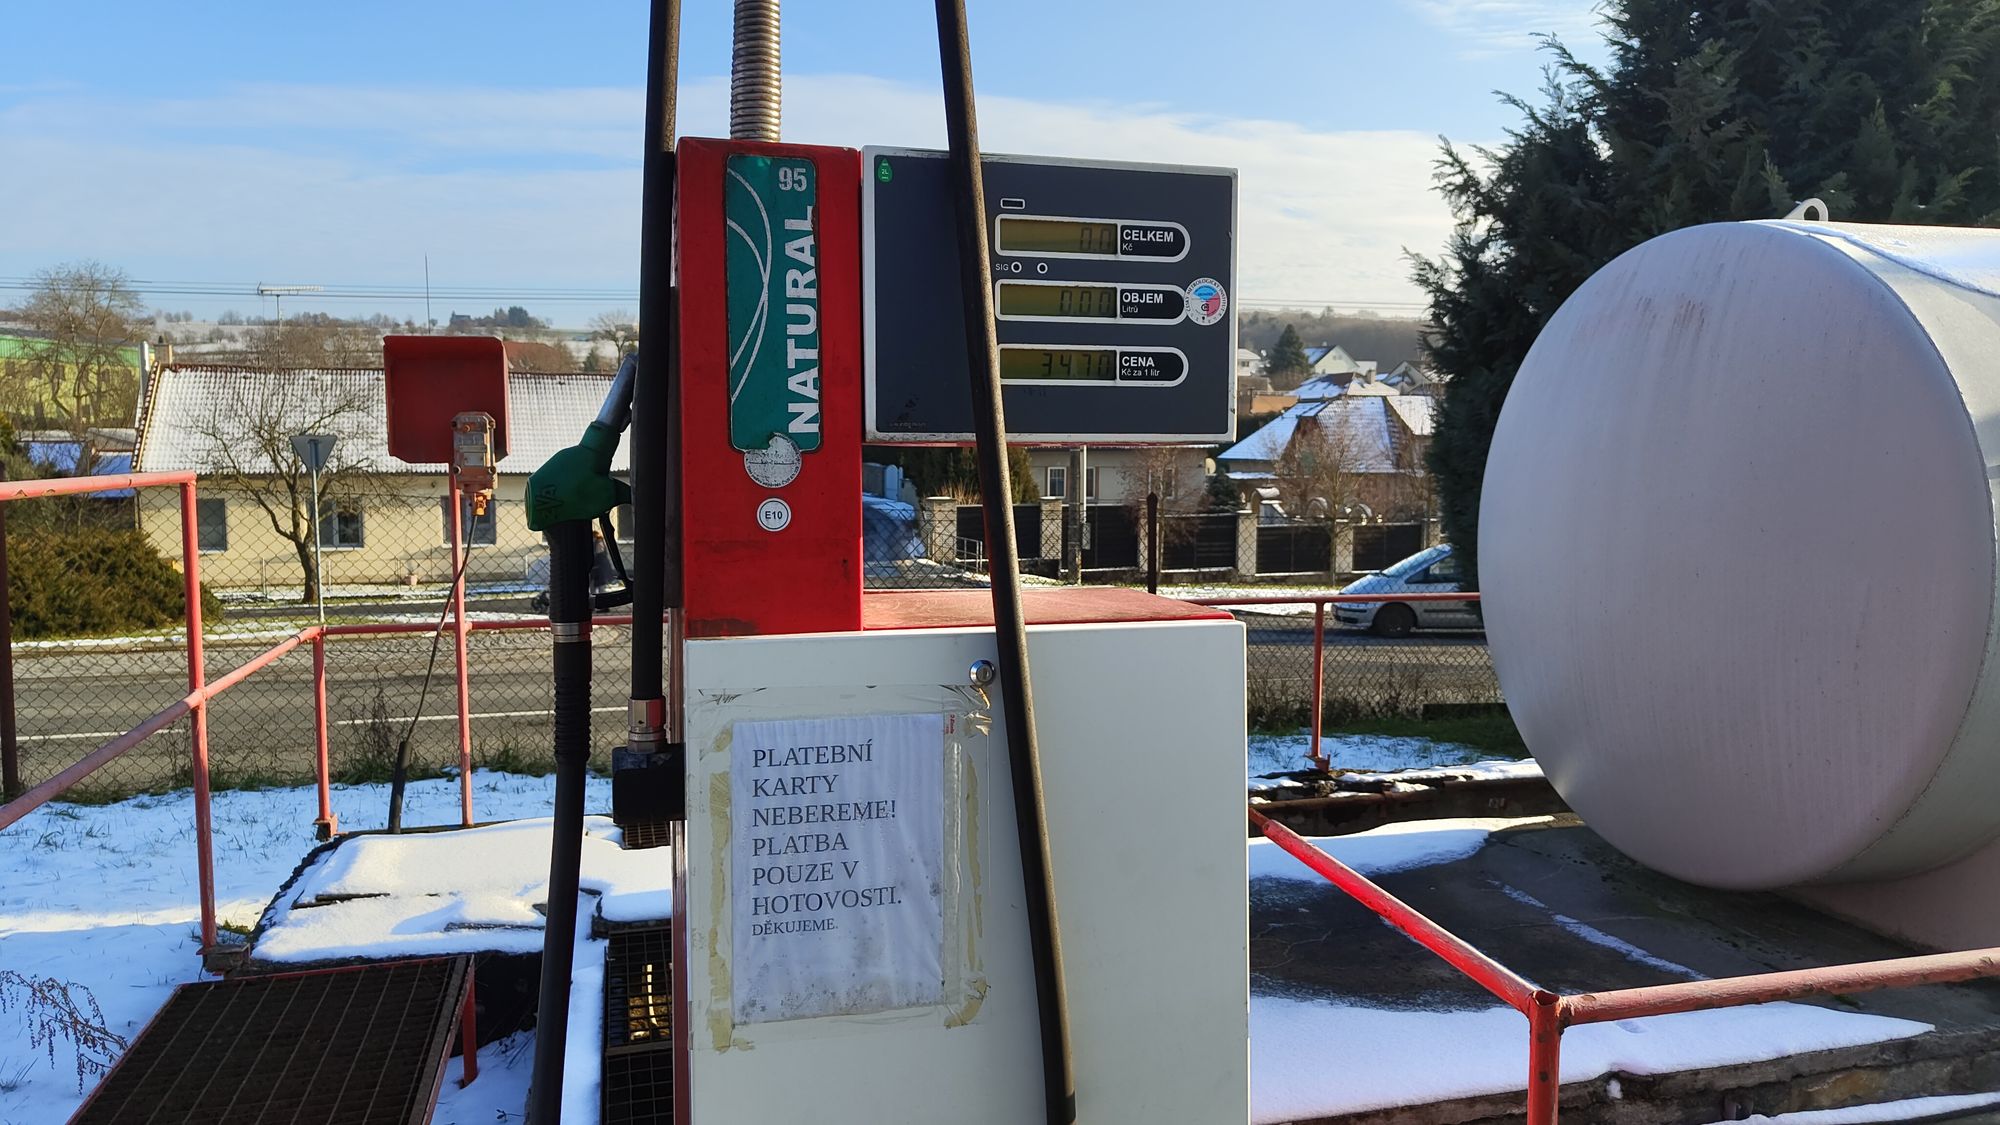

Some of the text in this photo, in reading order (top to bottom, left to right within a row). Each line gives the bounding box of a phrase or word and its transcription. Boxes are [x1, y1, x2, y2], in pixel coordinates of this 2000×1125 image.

[778, 167, 808, 192] 95
[1123, 229, 1174, 242] CELKEM
[1122, 243, 1133, 251] Kč
[995, 263, 1009, 271] SIG
[1122, 292, 1163, 304] OBJEM
[1122, 304, 1138, 313] Litrů
[785, 205, 819, 433] NATURAL
[1121, 356, 1155, 367] CENA
[1121, 368, 1132, 376] Kč
[1144, 368, 1148, 376] 1
[1150, 368, 1160, 376] litr
[764, 510, 783, 520] E10
[752, 738, 873, 768] PLATEBNÍ
[752, 774, 839, 797] KARTY
[752, 800, 896, 827] NEBEREME!
[752, 832, 849, 857] PLATBA
[752, 860, 860, 886] POUZE V
[752, 886, 902, 916] HOTOVOSTI.
[751, 918, 839, 936] DĚKUJEME.
